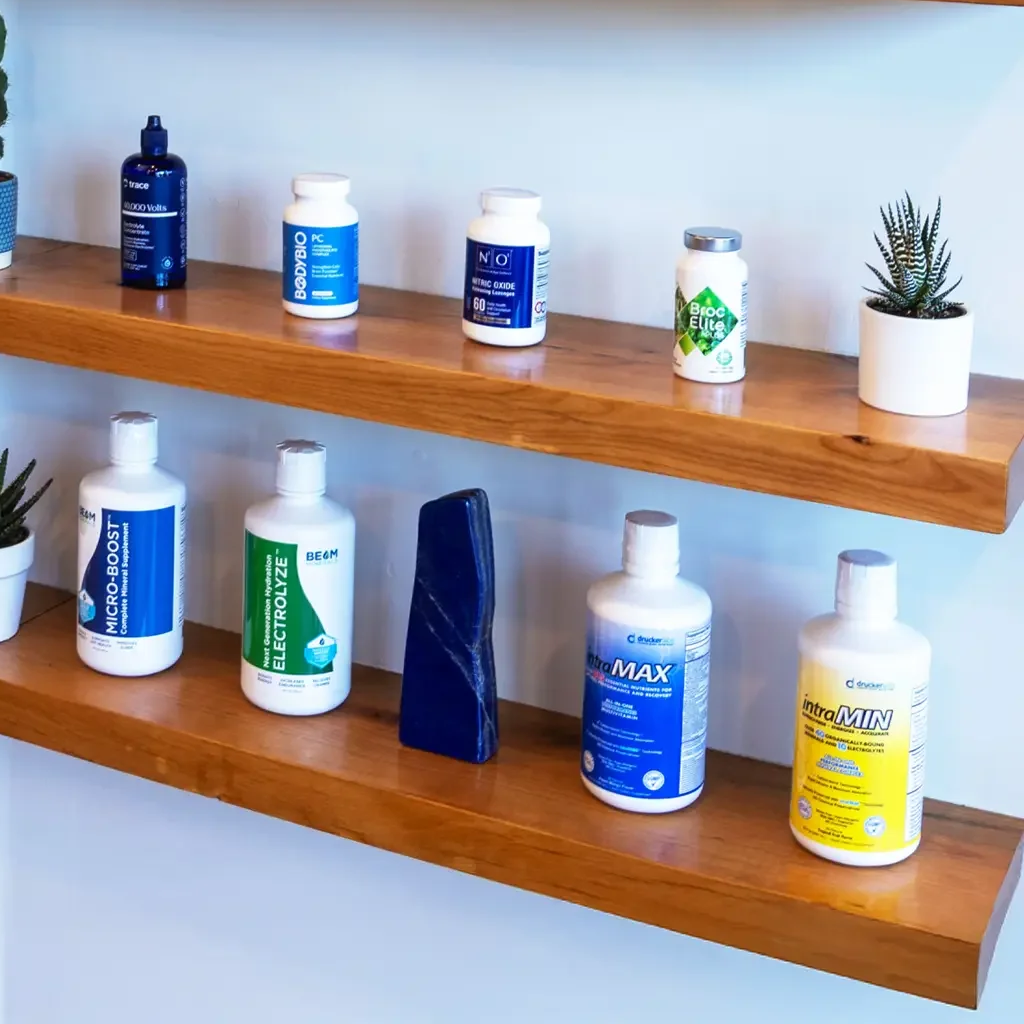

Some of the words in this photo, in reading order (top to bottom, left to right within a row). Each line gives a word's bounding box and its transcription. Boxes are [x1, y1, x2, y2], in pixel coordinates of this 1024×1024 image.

[129, 180, 149, 190] trace
[147, 204, 167, 212] Volts
[311, 233, 324, 243] PC
[472, 277, 492, 288] NITRIC
[493, 281, 516, 290] OXIDE
[473, 296, 485, 312] 60
[689, 302, 726, 318] Broc
[689, 316, 725, 332] Elite
[121, 522, 130, 568] Supplement
[106, 521, 119, 635] MICRO-BOOST
[121, 569, 129, 597] Mineral
[264, 554, 272, 598] Hydration
[120, 598, 129, 635] Complete
[263, 598, 272, 646] Generation
[273, 556, 288, 671] ELECTROLYZE
[802, 693, 893, 730] intraMIN
